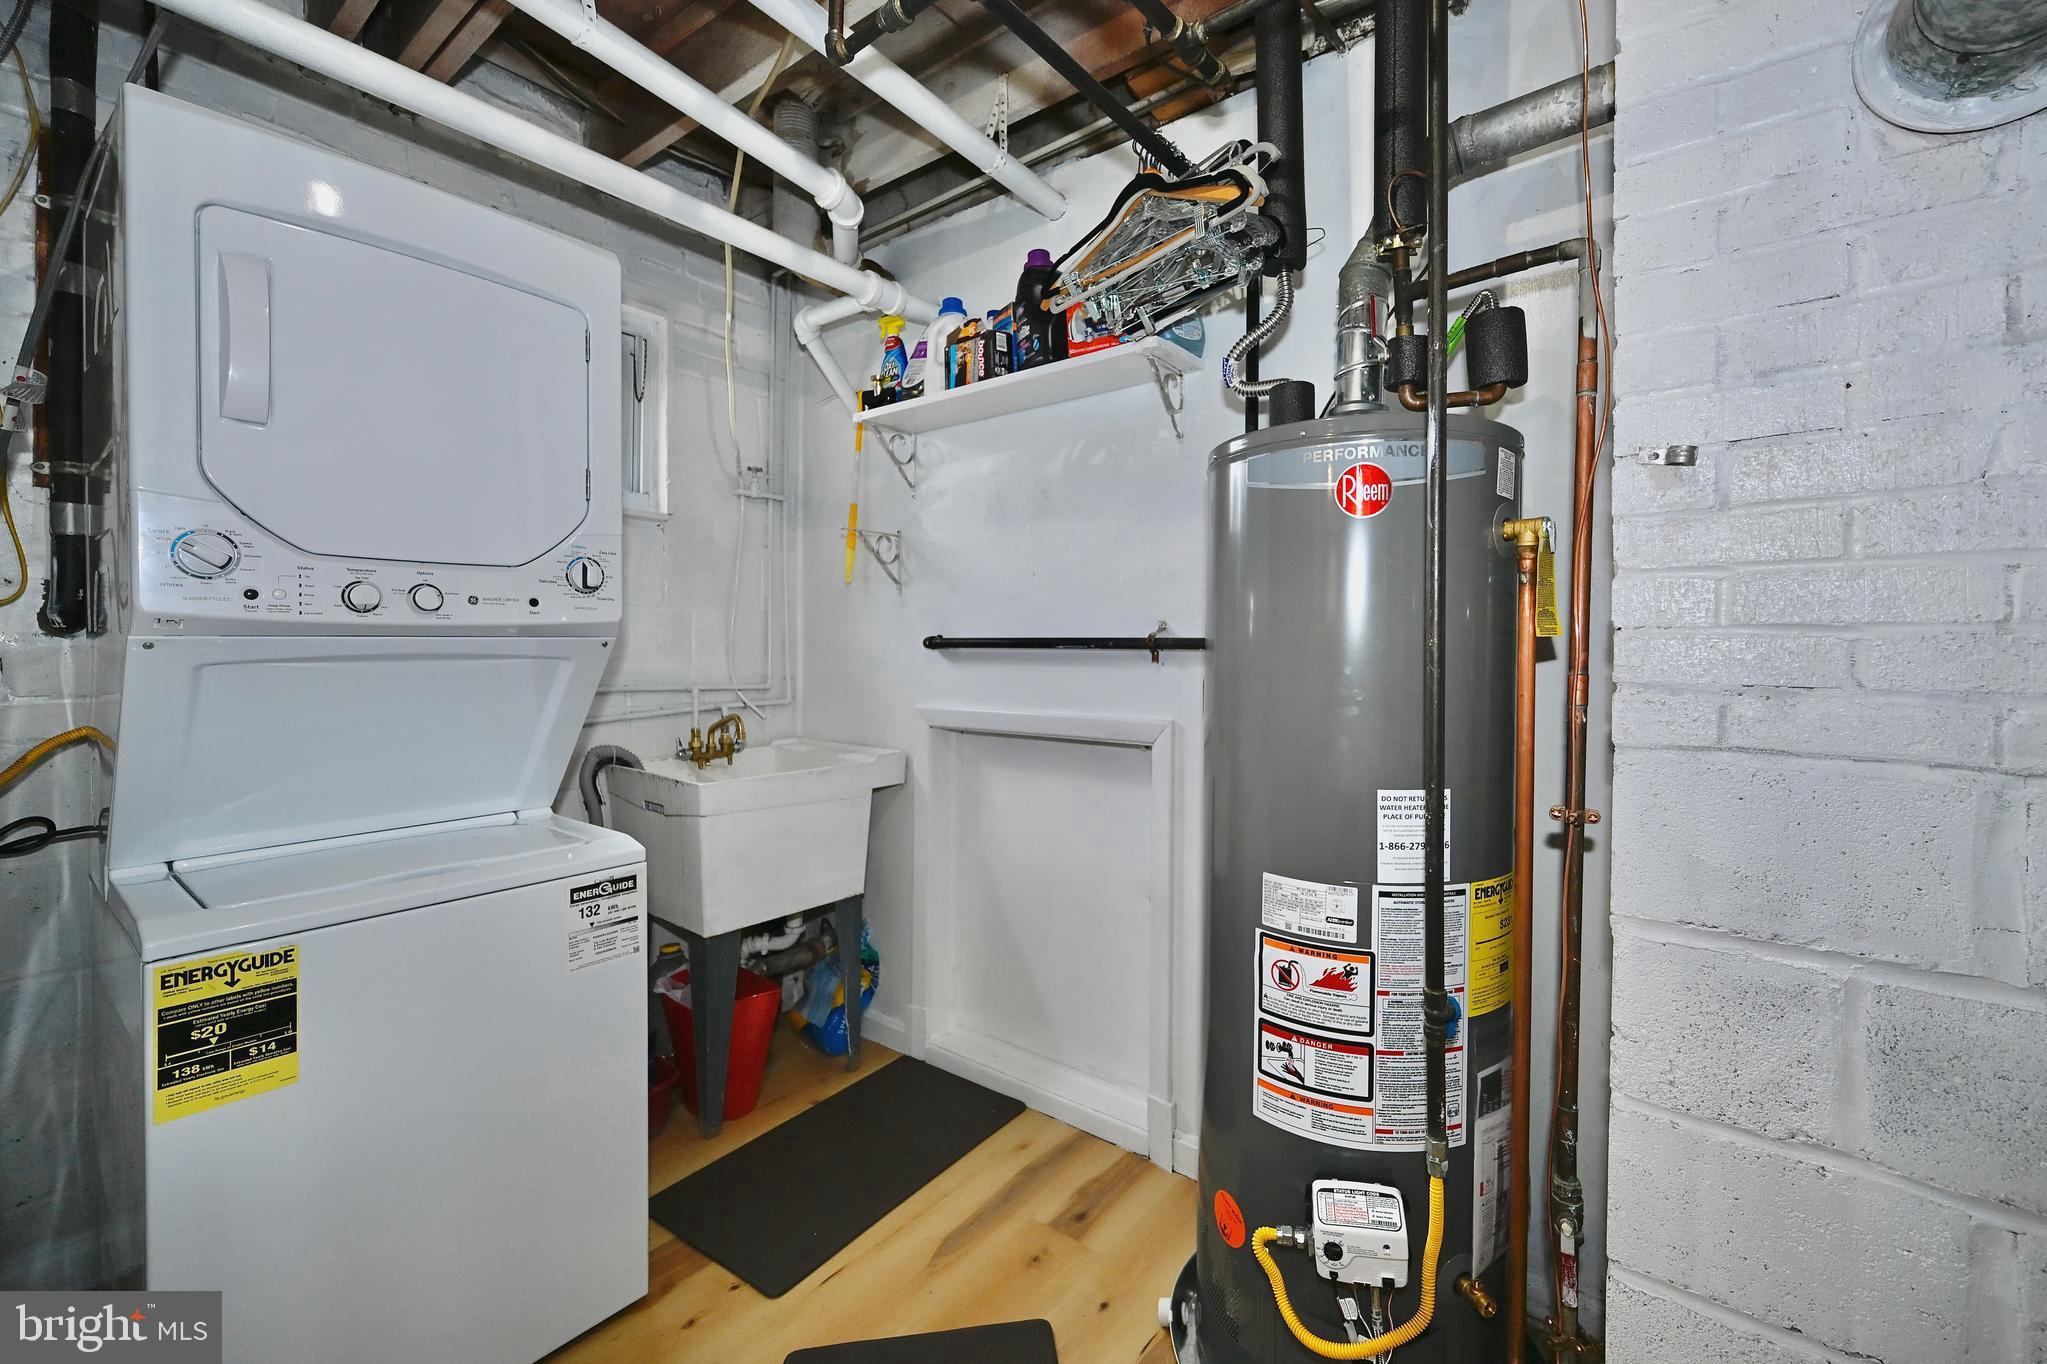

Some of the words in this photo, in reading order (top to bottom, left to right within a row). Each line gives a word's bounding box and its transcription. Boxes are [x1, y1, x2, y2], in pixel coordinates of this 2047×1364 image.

[573, 880, 634, 901] ENERGUIDE
[578, 904, 601, 920] 132
[1299, 948, 1338, 960] WARNING
[161, 949, 295, 990] ENERGYGUIDE
[161, 1007, 187, 1017] Compare
[188, 1003, 204, 1012] ONLY
[211, 997, 226, 1005] other
[226, 993, 241, 1002] labels
[243, 990, 254, 999] with
[193, 1015, 219, 1025] Estimated
[220, 1010, 236, 1019] Yearly
[236, 1006, 254, 1015] Energy
[190, 1022, 228, 1041] $20
[249, 1041, 277, 1056] $14
[1299, 1037, 1333, 1050] DANGER
[172, 1064, 200, 1079] 138
[1300, 1097, 1334, 1110] WARNING
